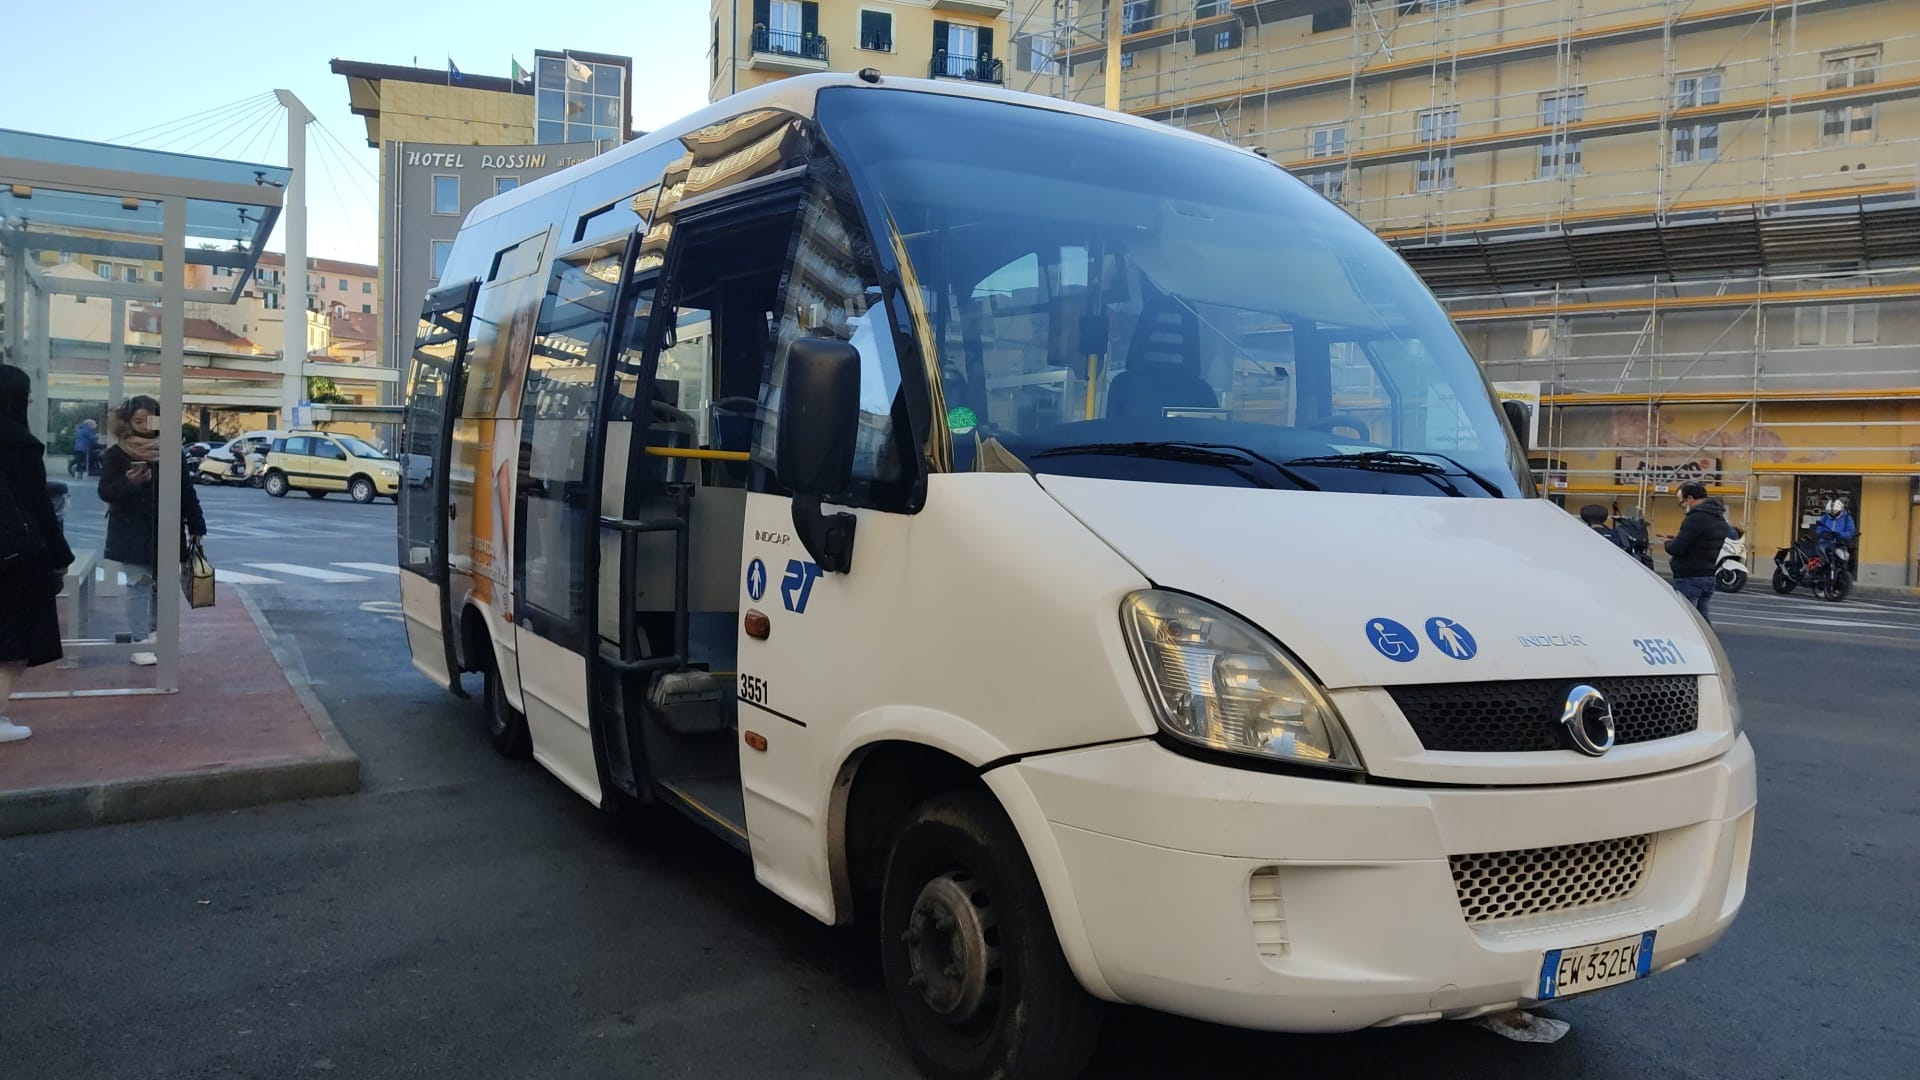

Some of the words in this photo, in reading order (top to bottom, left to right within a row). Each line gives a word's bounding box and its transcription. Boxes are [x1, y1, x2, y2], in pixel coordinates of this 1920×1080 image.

[406, 151, 464, 168] HOTEL
[481, 153, 546, 169] ROSSINI
[1632, 638, 1687, 666] 3551
[741, 673, 768, 705] 3551
